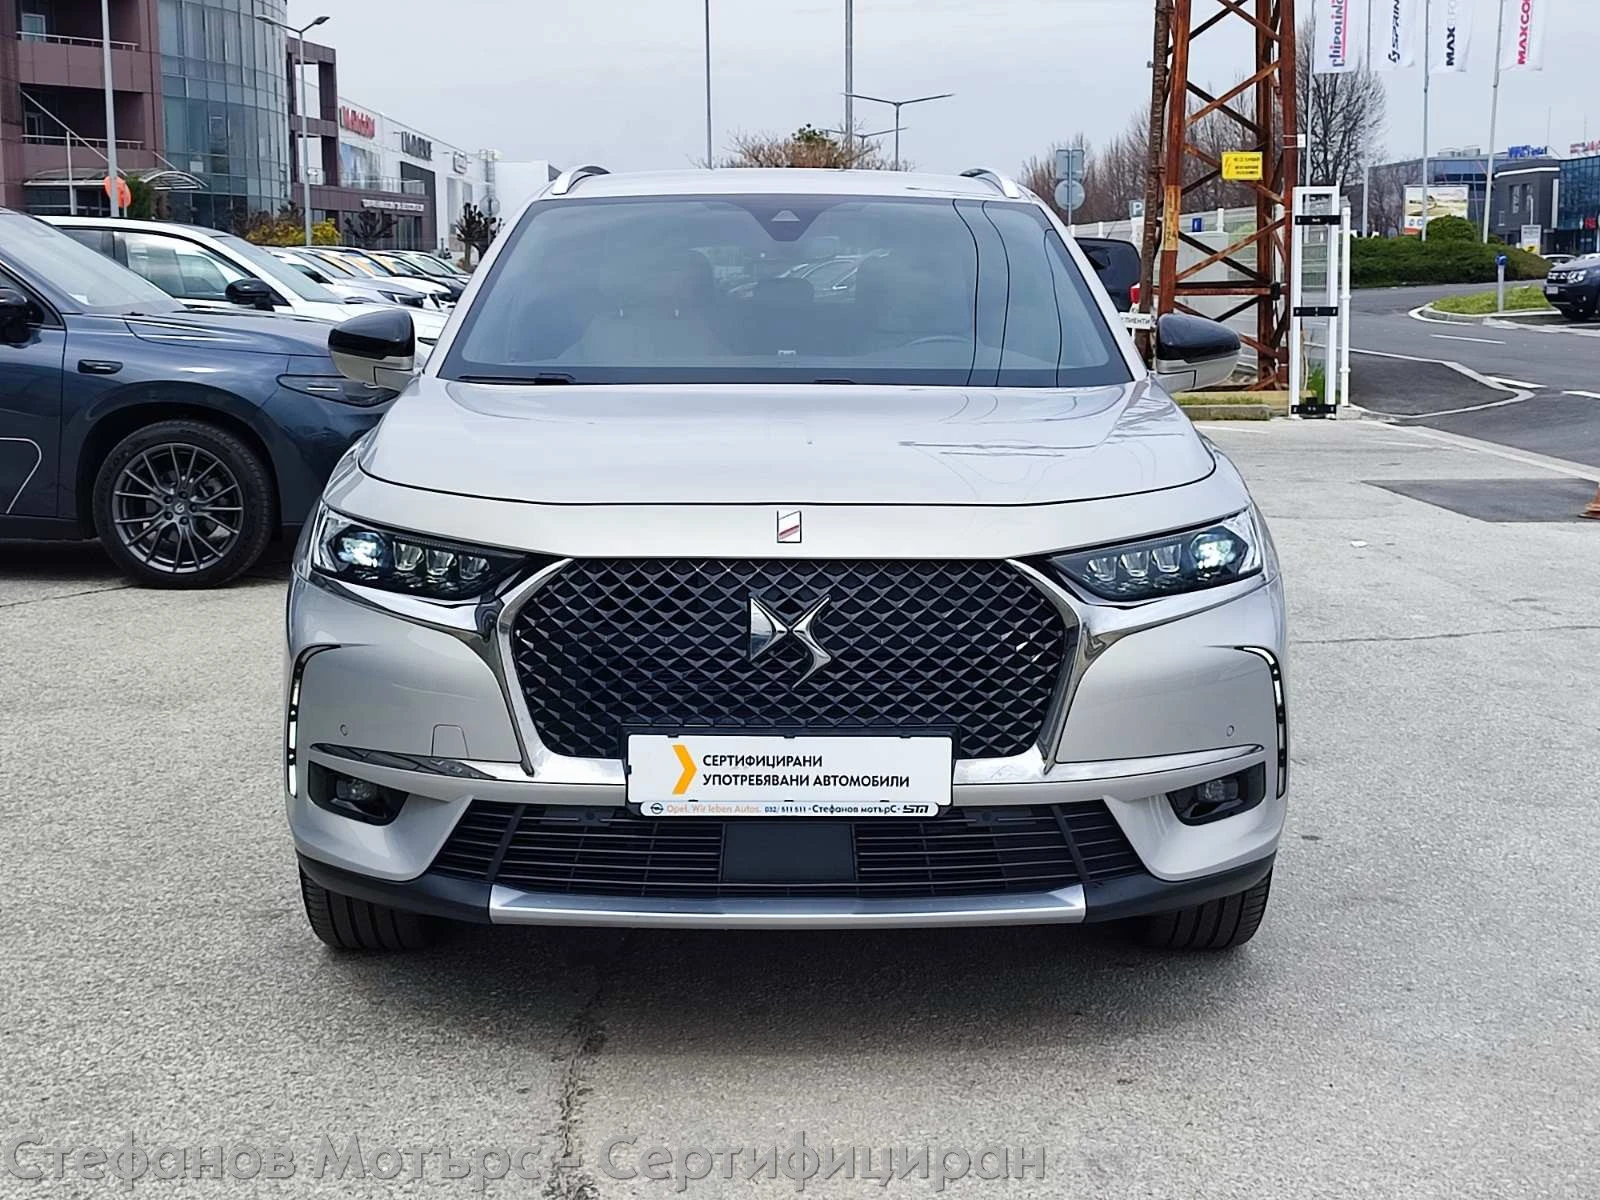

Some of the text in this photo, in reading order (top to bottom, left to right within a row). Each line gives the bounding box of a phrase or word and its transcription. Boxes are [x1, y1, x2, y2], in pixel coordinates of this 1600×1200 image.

[1517, 0, 1531, 65] MAXCO
[702, 754, 823, 769] СЕРТИФИЦИРАНИ
[702, 774, 910, 788] УПОТРЕБЯВАНИ АВТОМОБИЛИ
